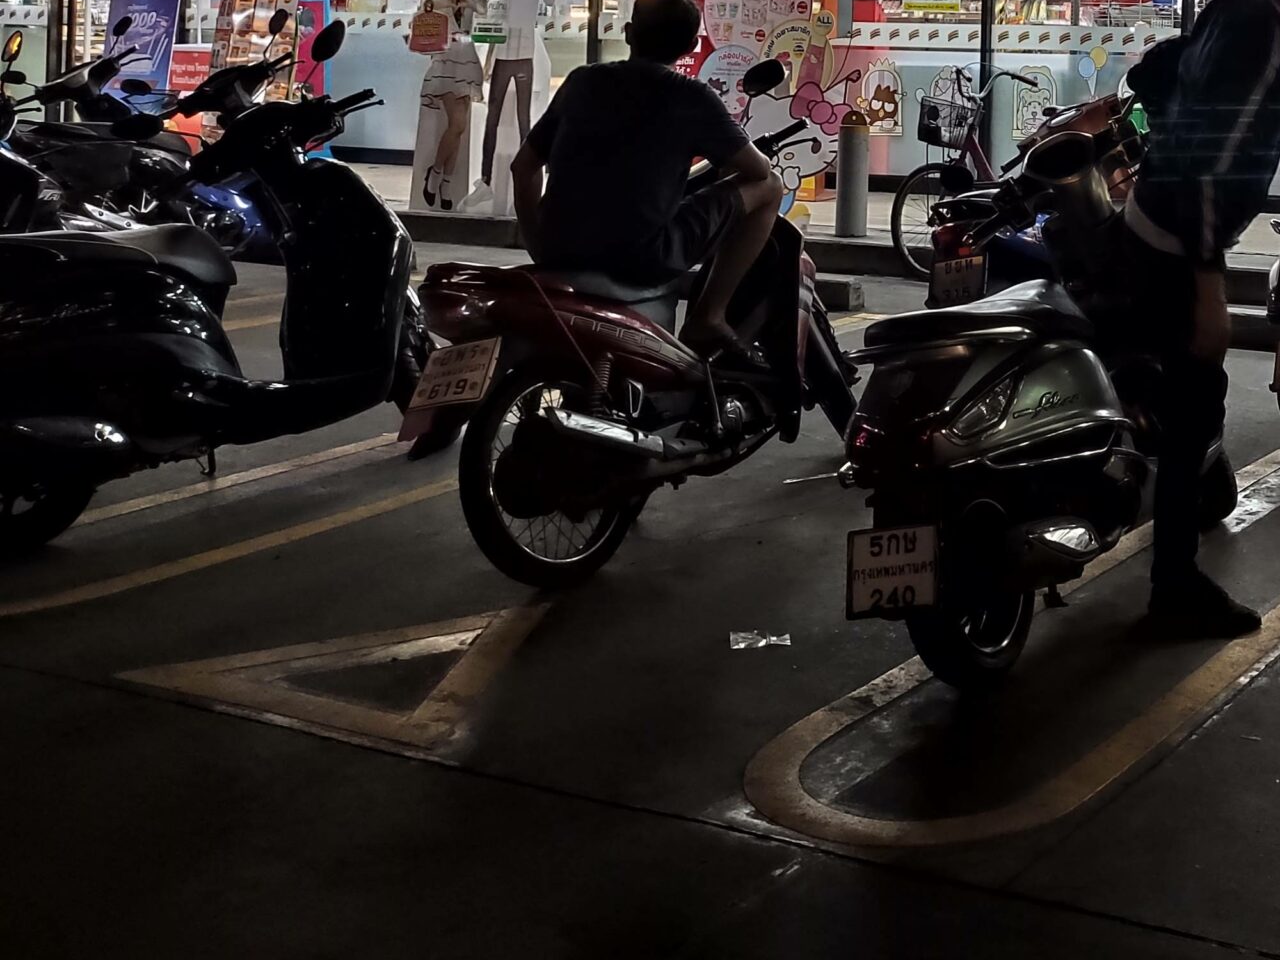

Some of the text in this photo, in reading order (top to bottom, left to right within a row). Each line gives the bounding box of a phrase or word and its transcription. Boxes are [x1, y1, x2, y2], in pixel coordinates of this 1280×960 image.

[427, 378, 468, 400] 619
[870, 530, 917, 557] 5กษ
[853, 560, 935, 585] กรุงเทพมหานคร
[870, 585, 916, 612] 240
